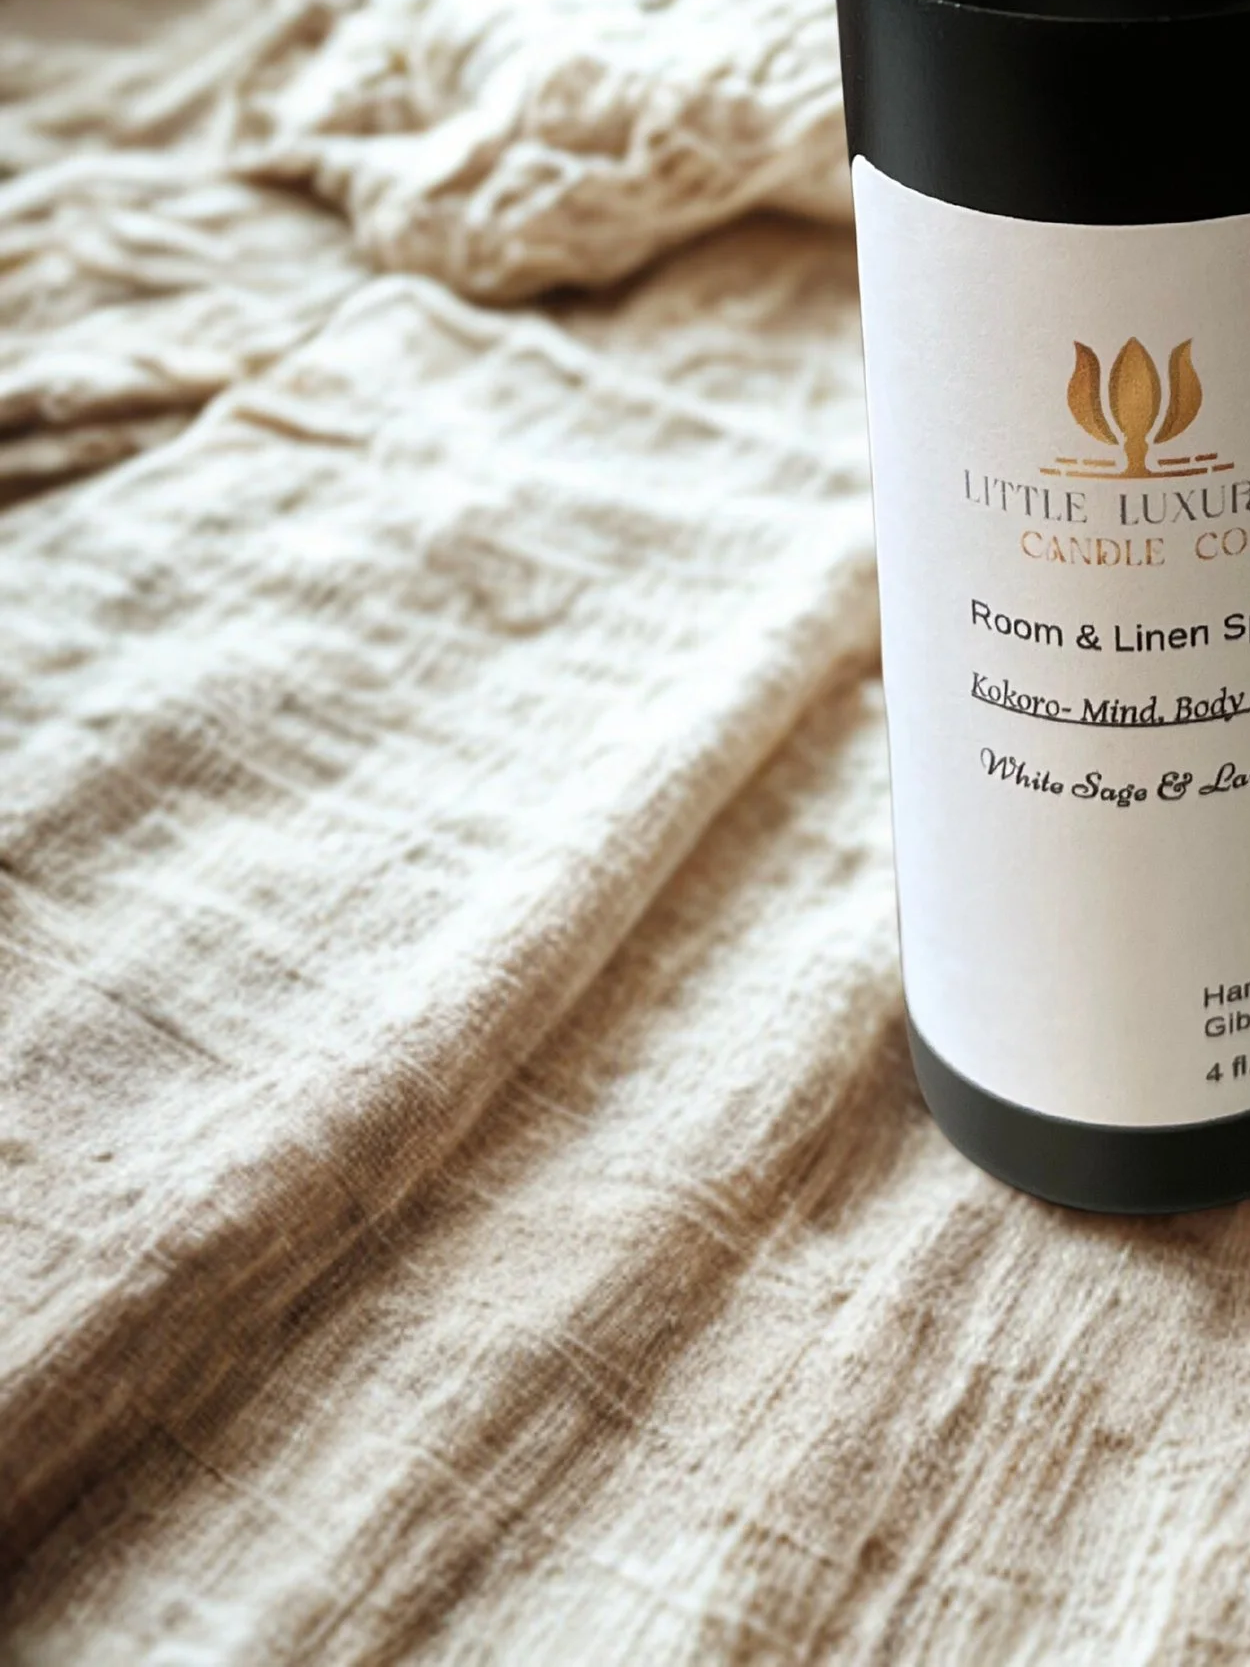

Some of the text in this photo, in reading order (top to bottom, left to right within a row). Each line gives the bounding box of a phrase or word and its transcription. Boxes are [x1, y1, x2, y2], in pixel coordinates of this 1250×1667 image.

[964, 468, 1088, 523] LITTLE
[1020, 530, 1166, 567] CANDLE
[970, 598, 1063, 647] Room
[1075, 623, 1102, 651] &
[1114, 623, 1209, 652] Linen
[970, 671, 1073, 720] Kokoro-
[1175, 686, 1246, 722] Body
[980, 747, 1064, 795] White
[1070, 771, 1148, 807] Sage
[1156, 771, 1194, 801] &
[1205, 1062, 1223, 1082] 4
